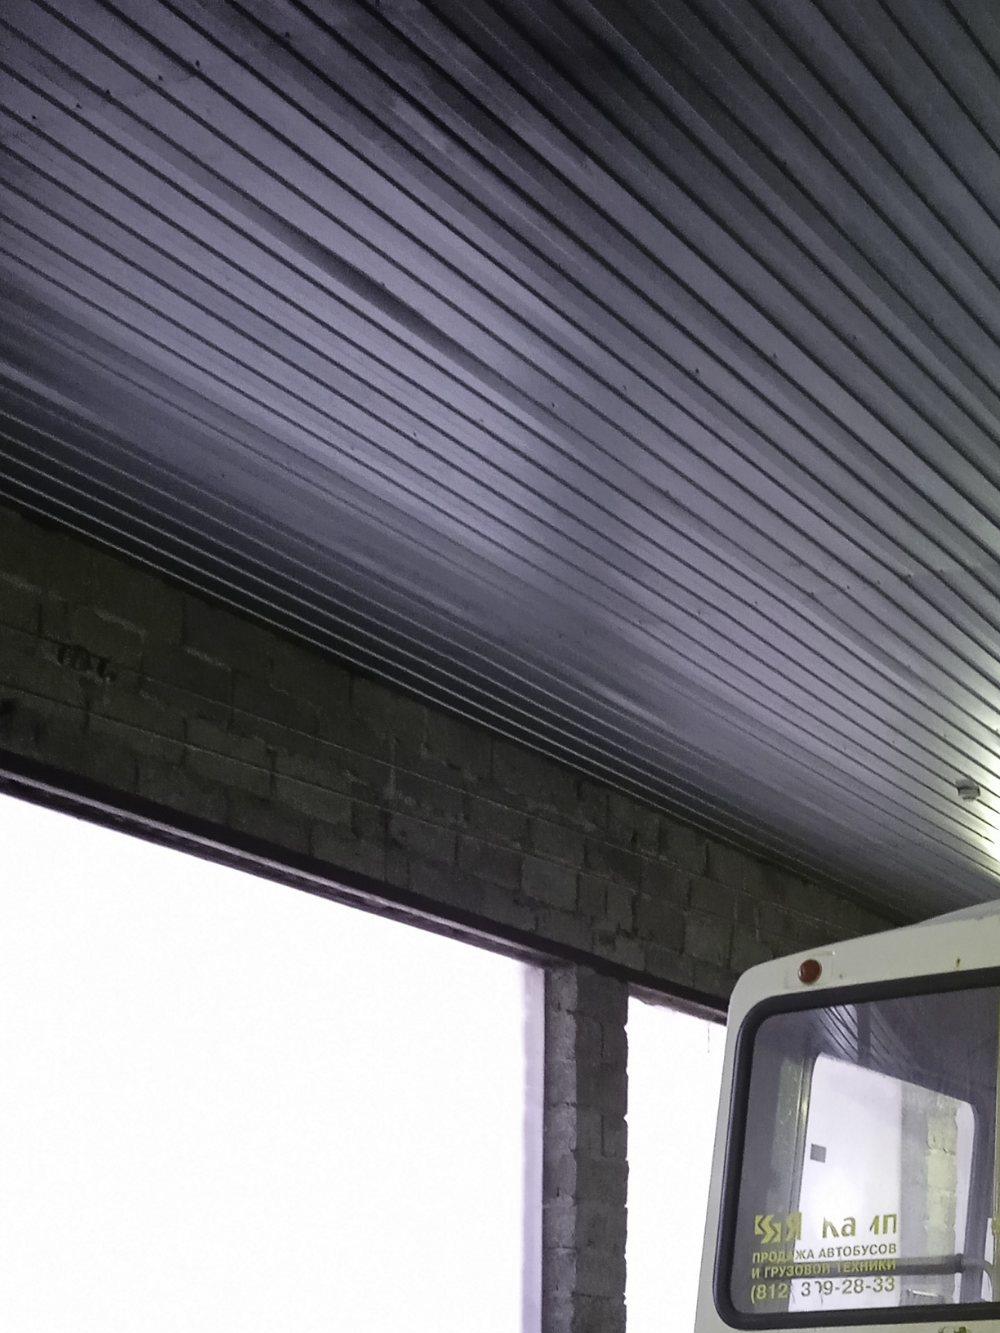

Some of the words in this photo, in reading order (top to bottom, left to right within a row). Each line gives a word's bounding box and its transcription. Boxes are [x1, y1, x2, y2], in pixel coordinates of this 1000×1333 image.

[752, 1250, 814, 1264] ПРОДЖА
[819, 1243, 897, 1258] АВТОБУСОВ
[751, 1267, 760, 1279] И
[836, 1259, 897, 1273] ТЕХНИКИ
